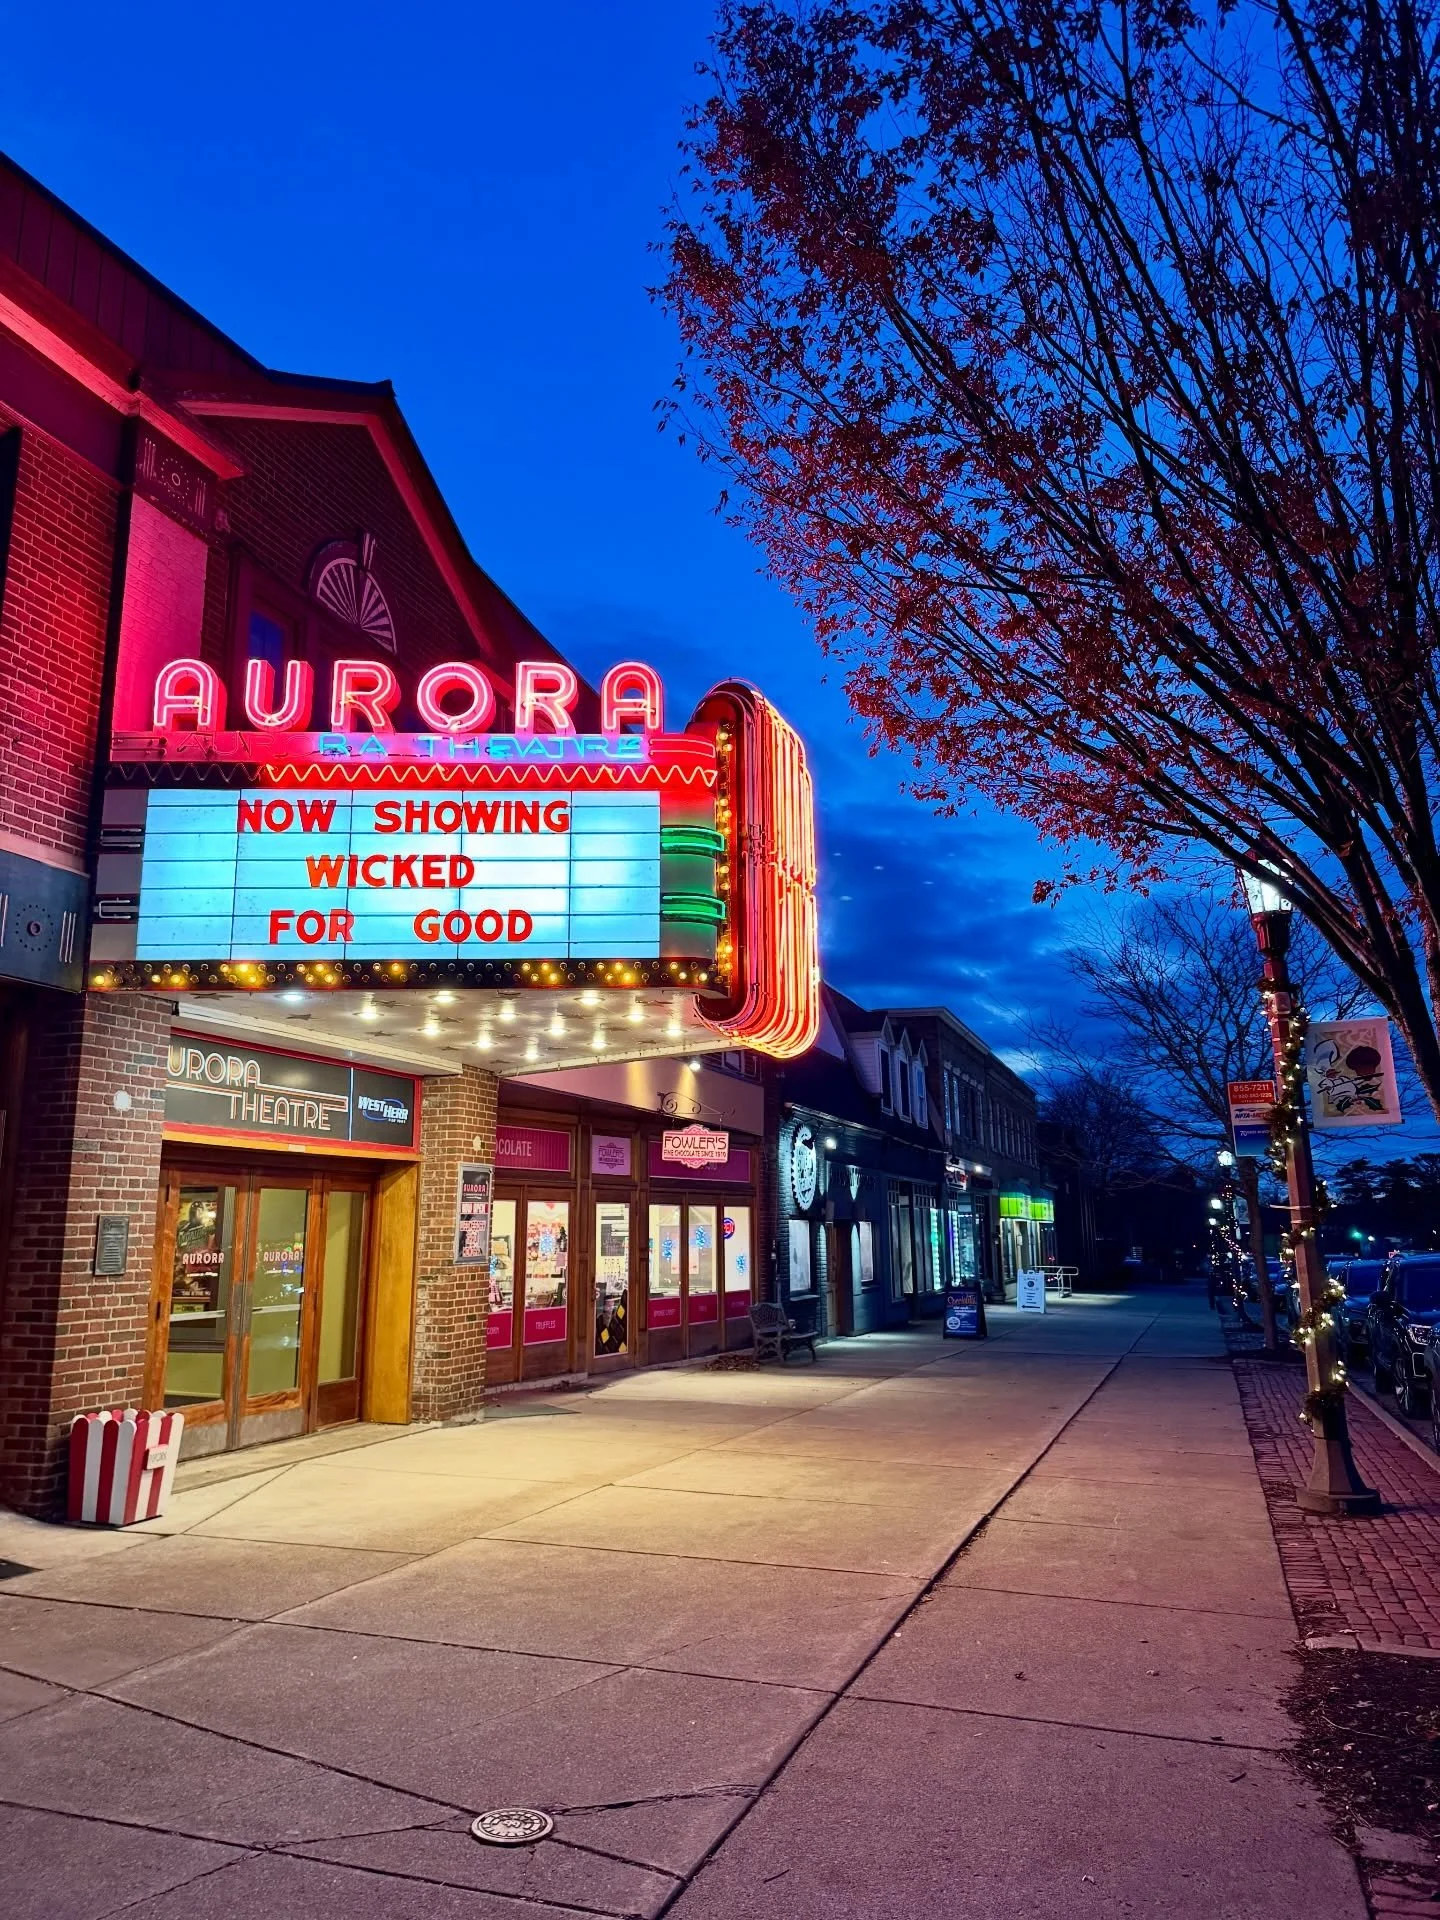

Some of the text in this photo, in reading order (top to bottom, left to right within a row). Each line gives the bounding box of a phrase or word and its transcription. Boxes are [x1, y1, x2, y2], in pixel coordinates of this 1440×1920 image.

[153, 658, 664, 733] AURORA
[418, 735, 644, 759] THEATRE
[236, 799, 570, 833] NOW SHOWING
[305, 854, 475, 888] WICKED
[268, 909, 533, 944] FOR GOOD
[167, 1044, 260, 1089] URORA
[229, 1091, 331, 1131] THEATRE
[358, 1096, 409, 1120] WEST HERR
[495, 1139, 532, 1157] COLATE
[664, 1136, 727, 1150] FOWLER'S
[664, 1149, 674, 1157] FINE
[674, 1149, 701, 1158] CHOCOLATE
[701, 1150, 714, 1158] SINCE
[182, 1252, 225, 1265] AURORA
[263, 1251, 299, 1262] AURORA
